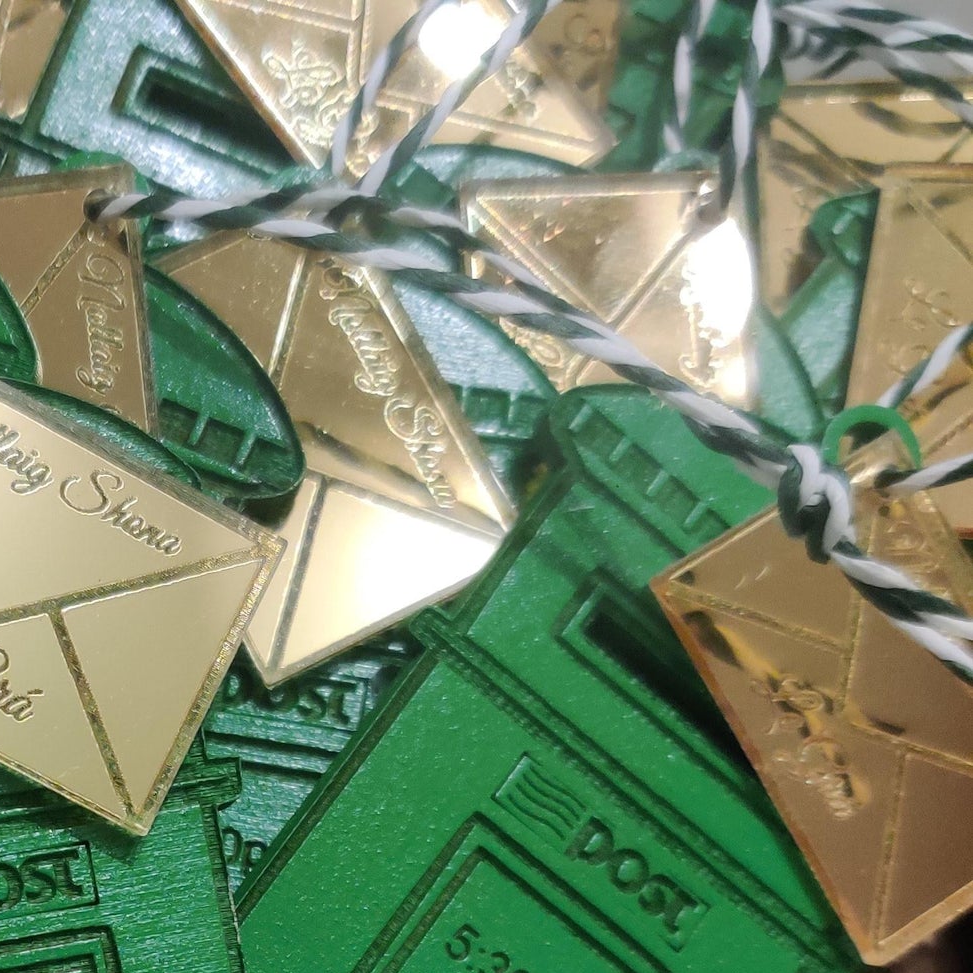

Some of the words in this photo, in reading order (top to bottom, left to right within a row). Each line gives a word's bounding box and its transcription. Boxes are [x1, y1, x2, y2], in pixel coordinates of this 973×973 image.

[77, 240, 126, 396] Nollaig
[59, 468, 183, 558] Shona
[564, 815, 699, 936] POST
